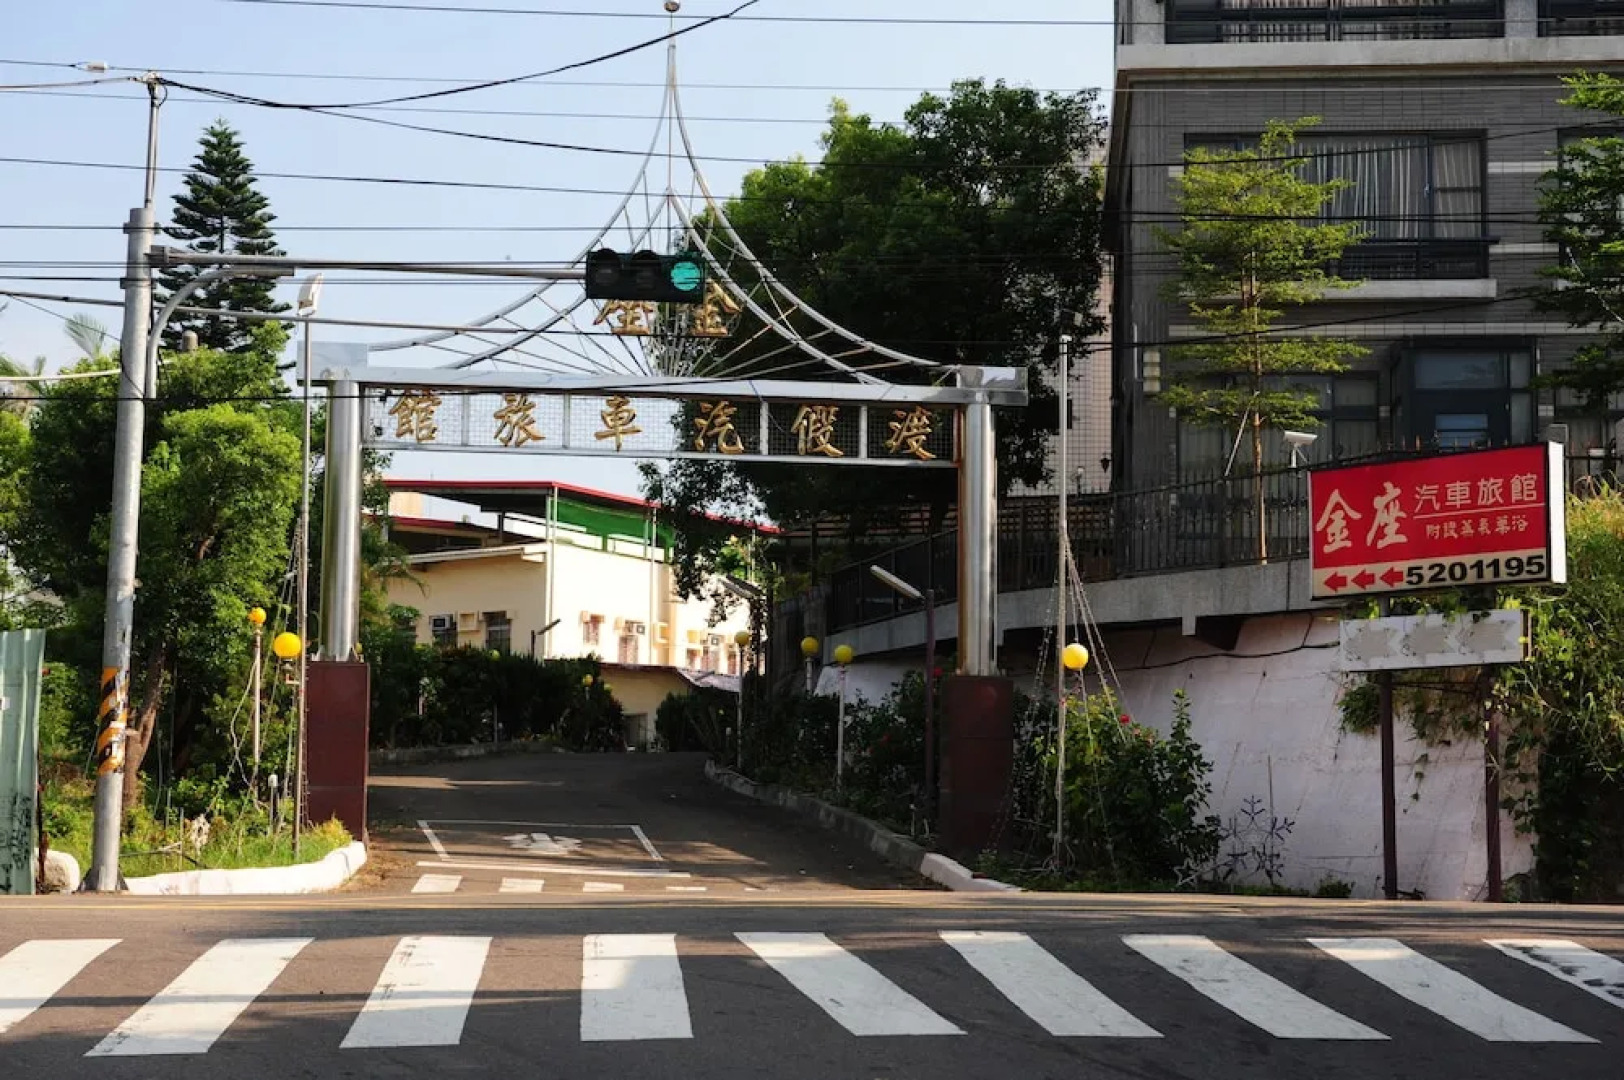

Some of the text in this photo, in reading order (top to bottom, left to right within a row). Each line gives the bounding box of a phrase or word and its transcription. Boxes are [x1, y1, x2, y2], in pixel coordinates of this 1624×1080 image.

[1414, 473, 1537, 513] 汽車旅館
[1316, 481, 1408, 553] 金座
[1405, 554, 1545, 586] 5201195
